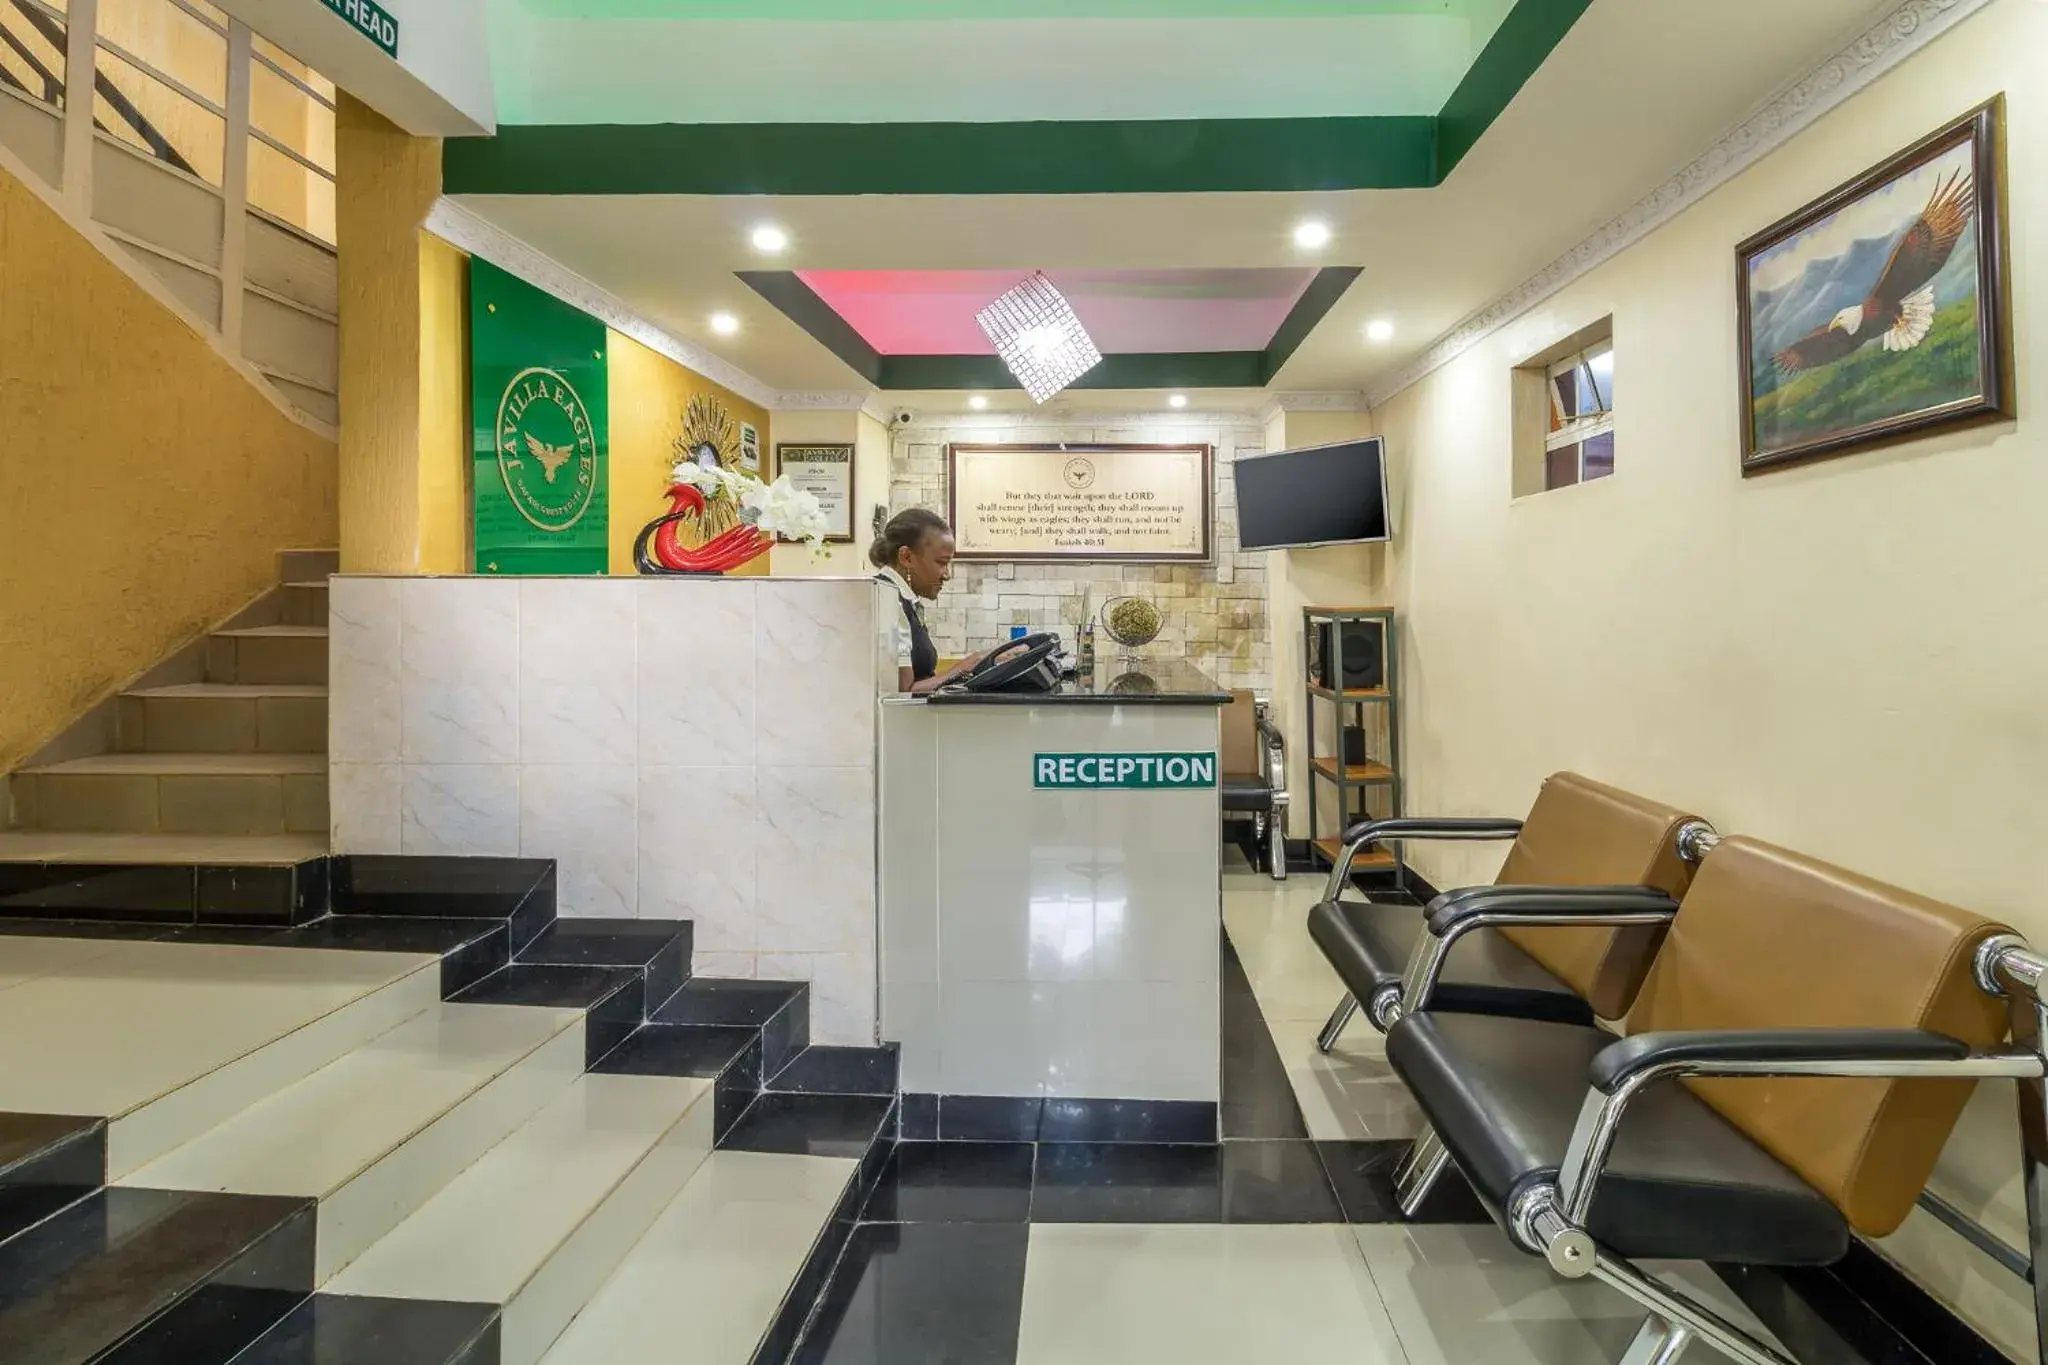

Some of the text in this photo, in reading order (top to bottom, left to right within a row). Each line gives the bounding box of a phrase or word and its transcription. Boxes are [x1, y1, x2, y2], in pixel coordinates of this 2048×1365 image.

[345, 0, 395, 47] HEAD
[503, 379, 592, 487] JAVILLA EAGLES
[1005, 492, 1021, 500] But
[1024, 492, 1041, 502] they
[1125, 492, 1154, 500] LORD
[976, 503, 997, 512] shall
[1098, 503, 1116, 514] they
[1119, 503, 1139, 512] shall
[1172, 505, 1184, 514] up
[979, 515, 998, 523] with
[1000, 515, 1026, 525] wings
[1040, 515, 1070, 525] eagles;
[1072, 515, 1089, 525] they
[1093, 515, 1113, 523] shall
[1136, 515, 1151, 523] and
[1154, 515, 1168, 523] not
[1170, 515, 1182, 523] be
[1045, 527, 1063, 536] they
[1066, 527, 1086, 535] shall
[1114, 527, 1130, 535] and
[1038, 757, 1212, 783] RECEPTION
